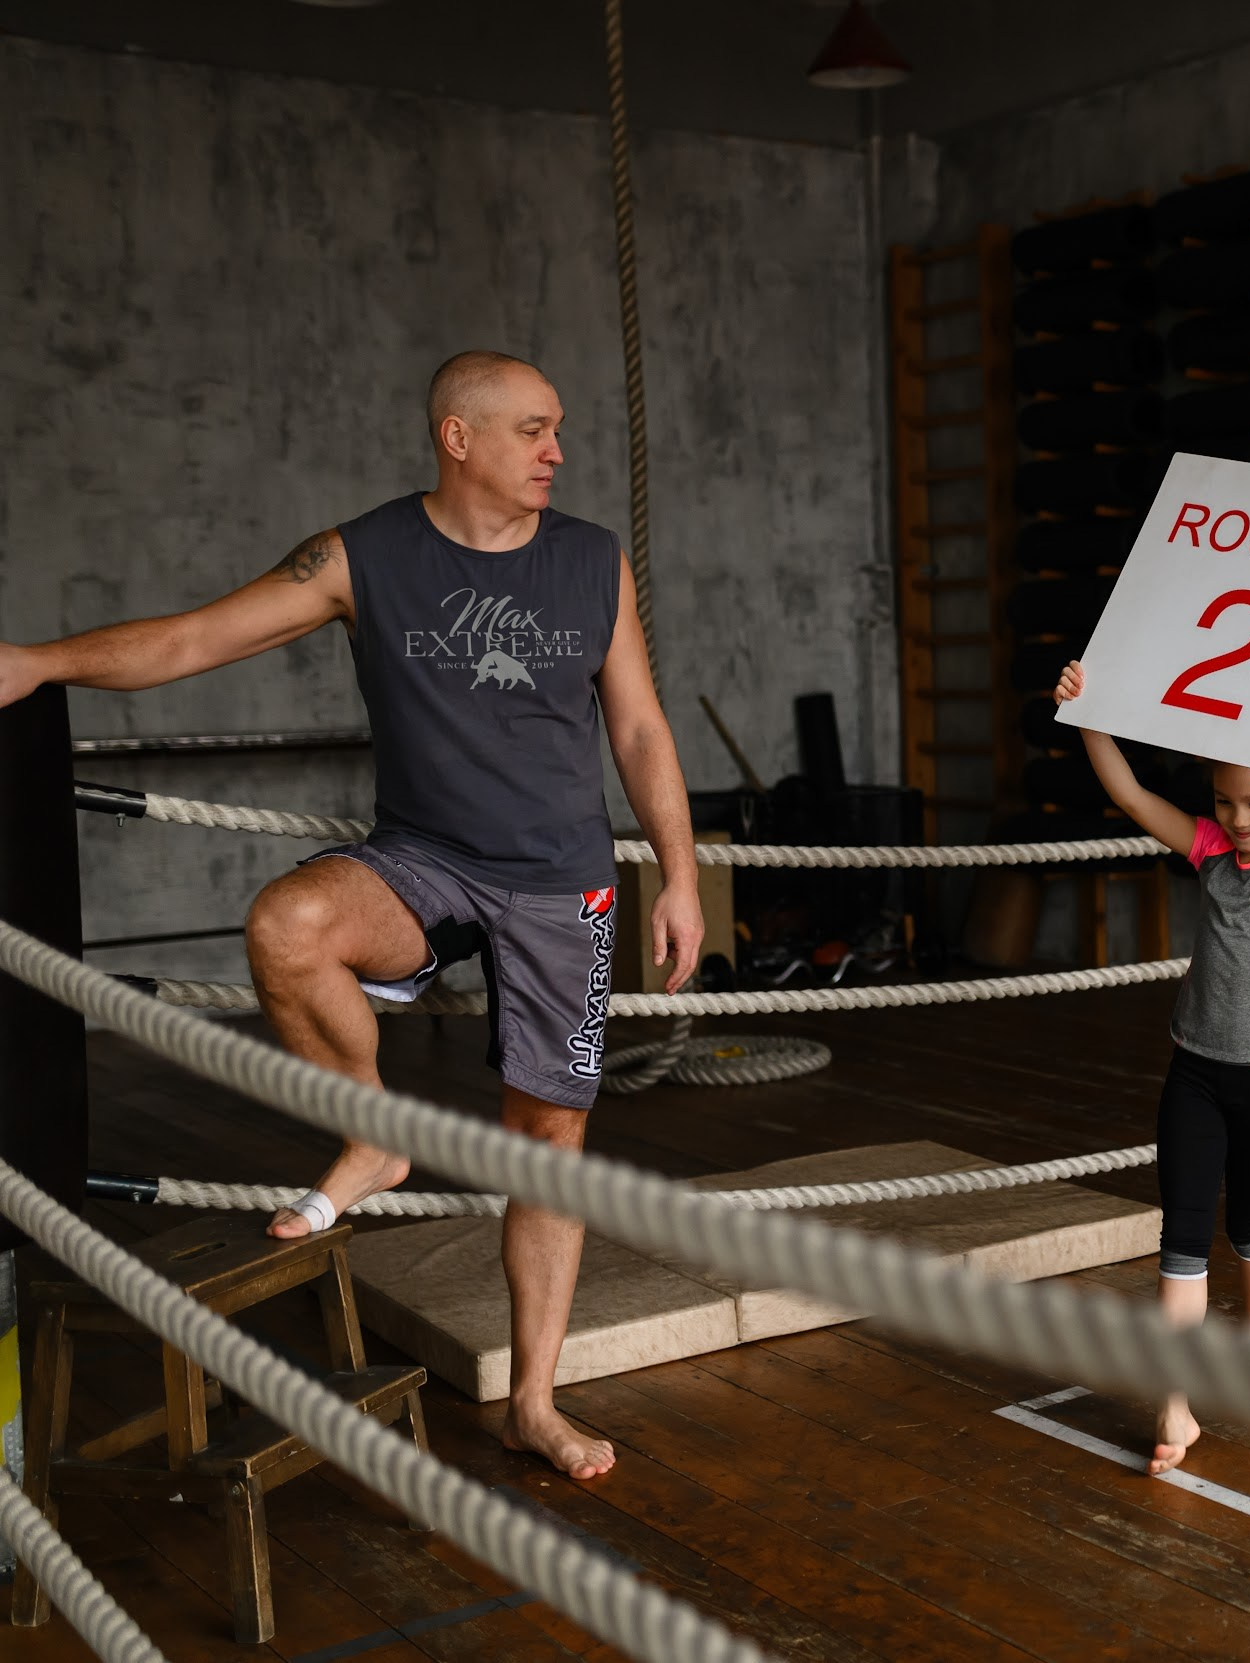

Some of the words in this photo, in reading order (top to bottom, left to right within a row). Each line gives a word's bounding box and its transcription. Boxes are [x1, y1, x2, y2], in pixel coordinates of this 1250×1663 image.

[440, 587, 548, 642] Max
[404, 630, 583, 657] EXTREME
[437, 662, 467, 670] SINCE
[531, 661, 555, 670] 2009
